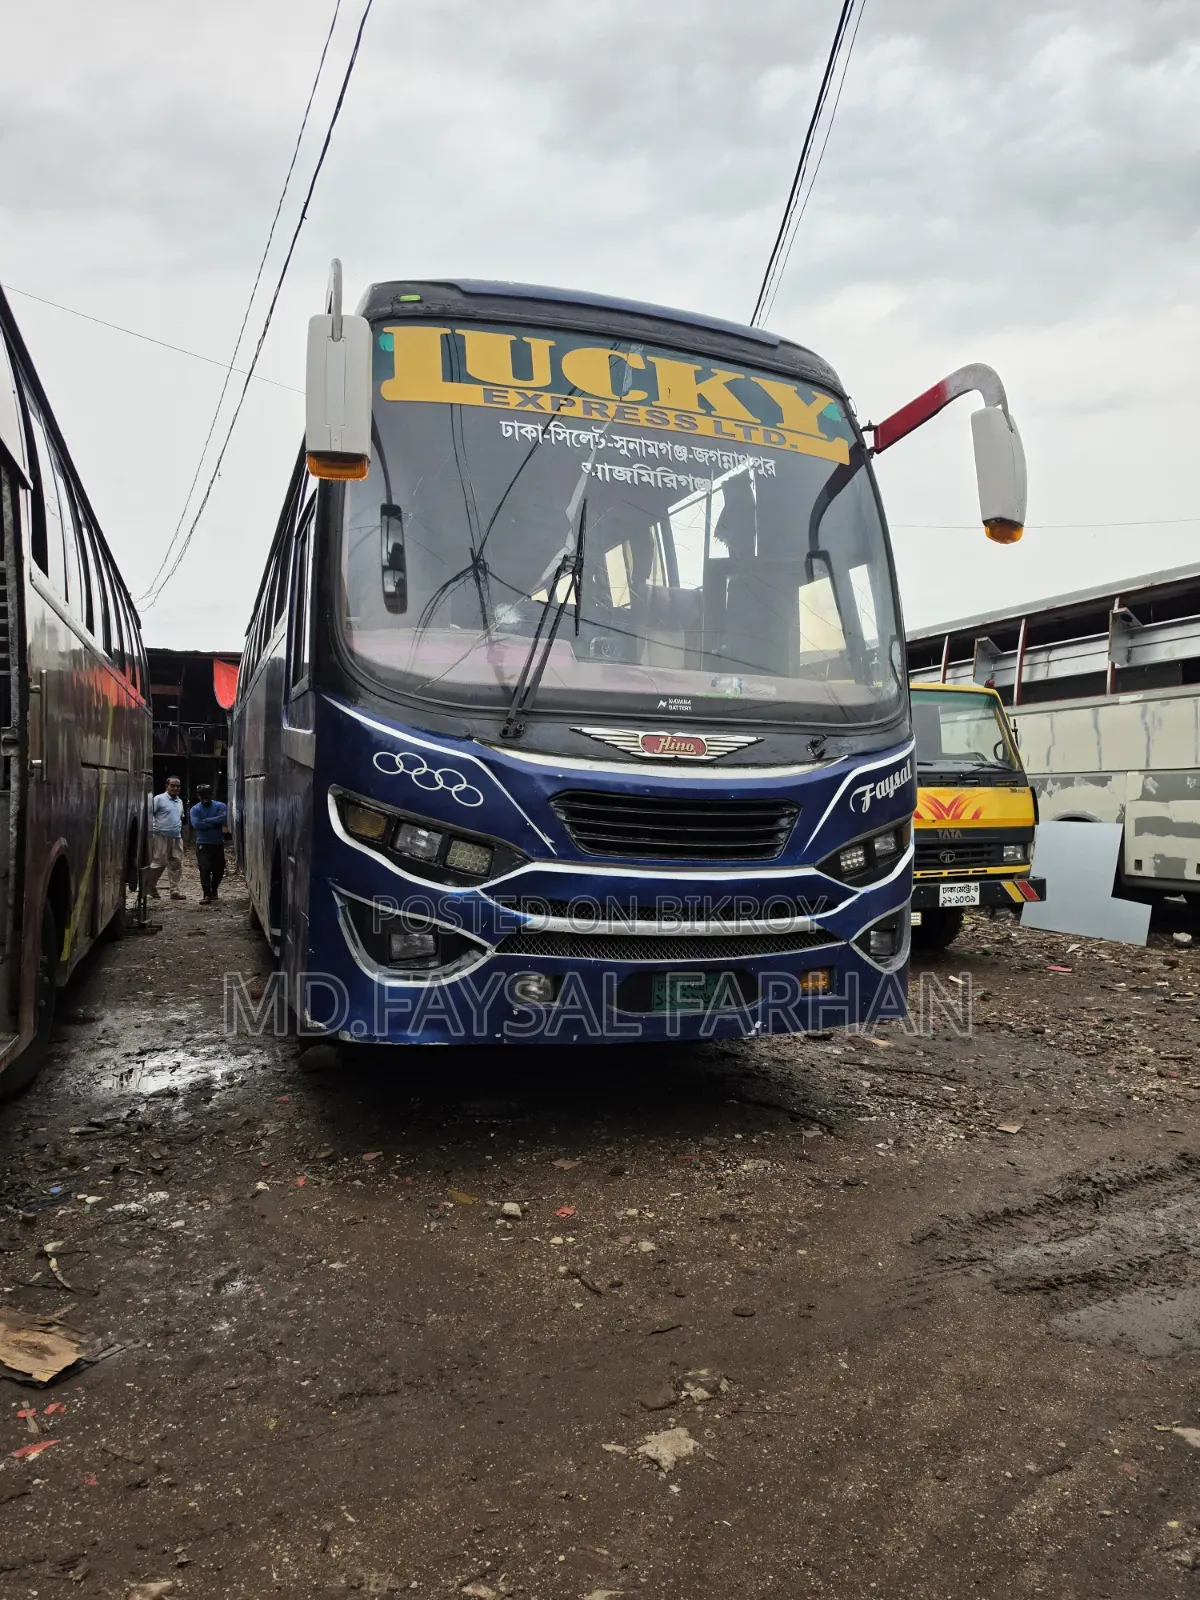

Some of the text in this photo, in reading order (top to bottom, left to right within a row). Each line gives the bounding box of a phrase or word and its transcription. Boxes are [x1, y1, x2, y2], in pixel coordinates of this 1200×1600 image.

[380, 326, 842, 445] LUCKY
[483, 388, 798, 449] EXPRESS LTD.
[653, 736, 697, 755] Hino
[849, 758, 912, 813] Faysal
[936, 829, 963, 839] TATA
